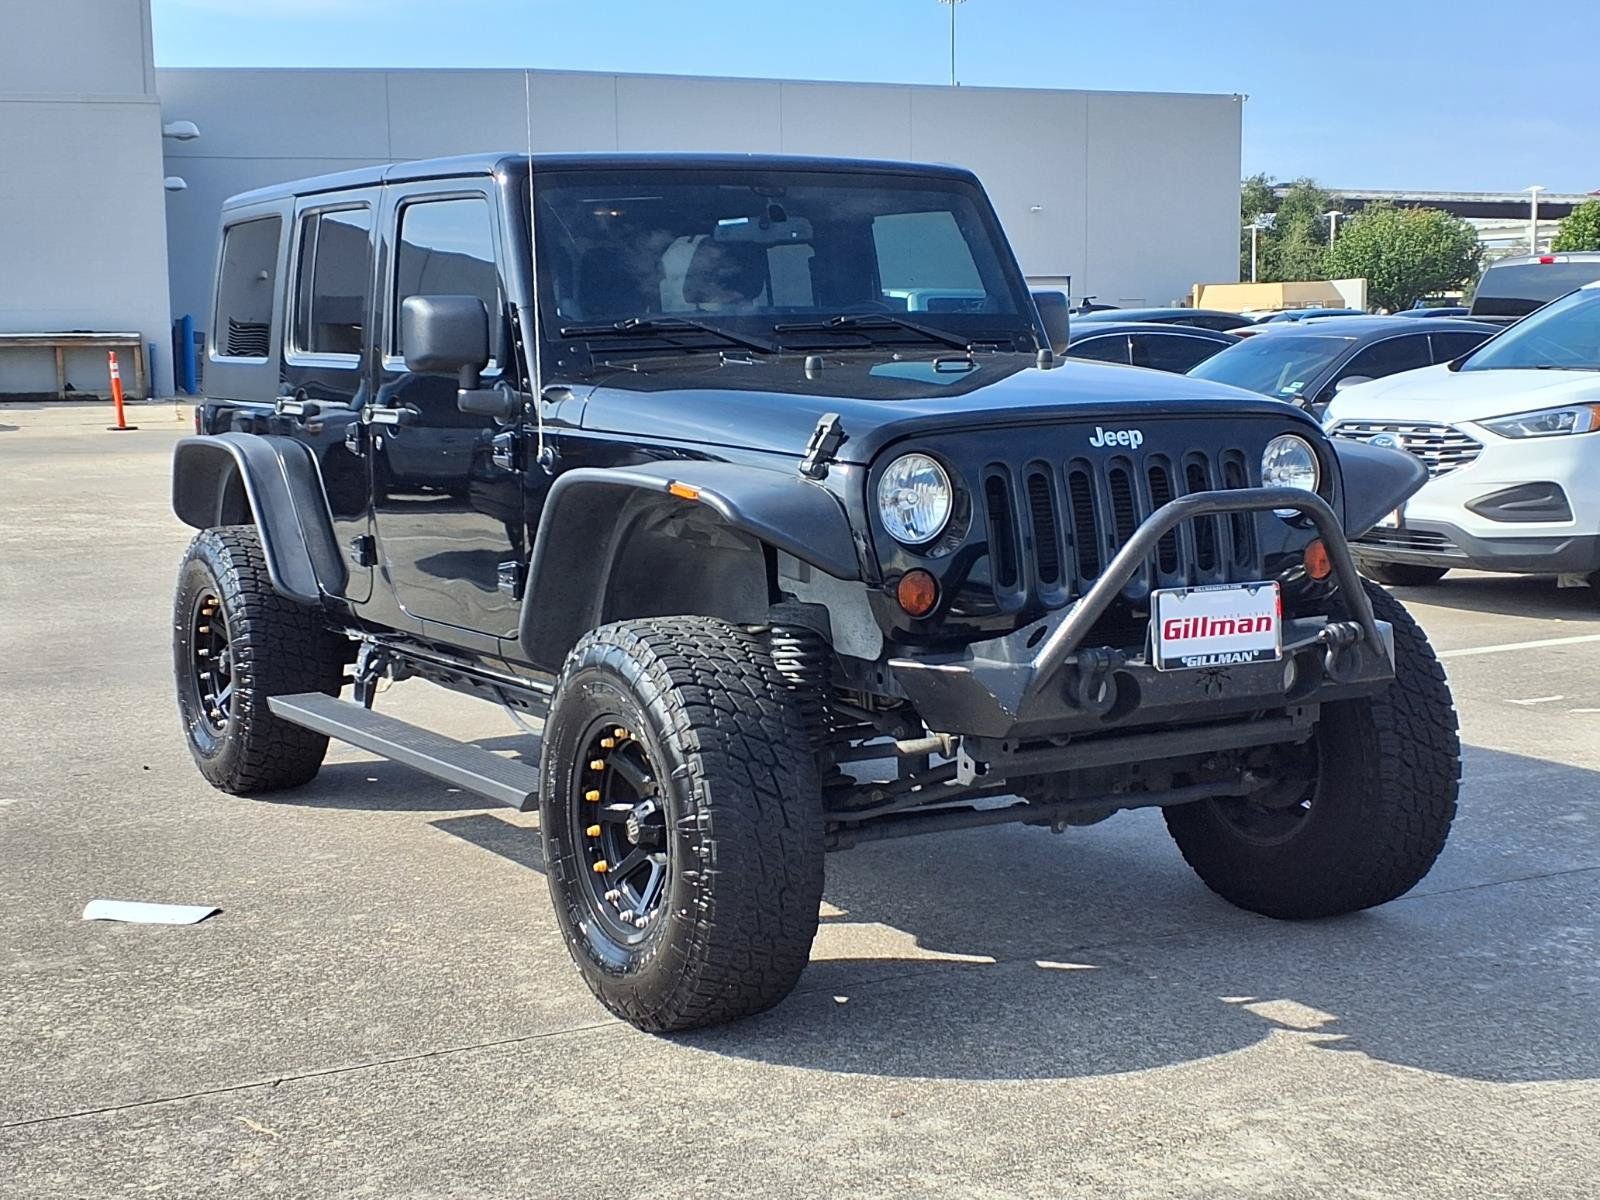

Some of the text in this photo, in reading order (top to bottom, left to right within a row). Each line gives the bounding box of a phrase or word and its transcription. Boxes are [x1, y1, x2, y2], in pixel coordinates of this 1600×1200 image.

[1089, 426, 1144, 449] Jeep
[1164, 616, 1272, 640] Gillman
[1186, 651, 1253, 667] GILLMAN
